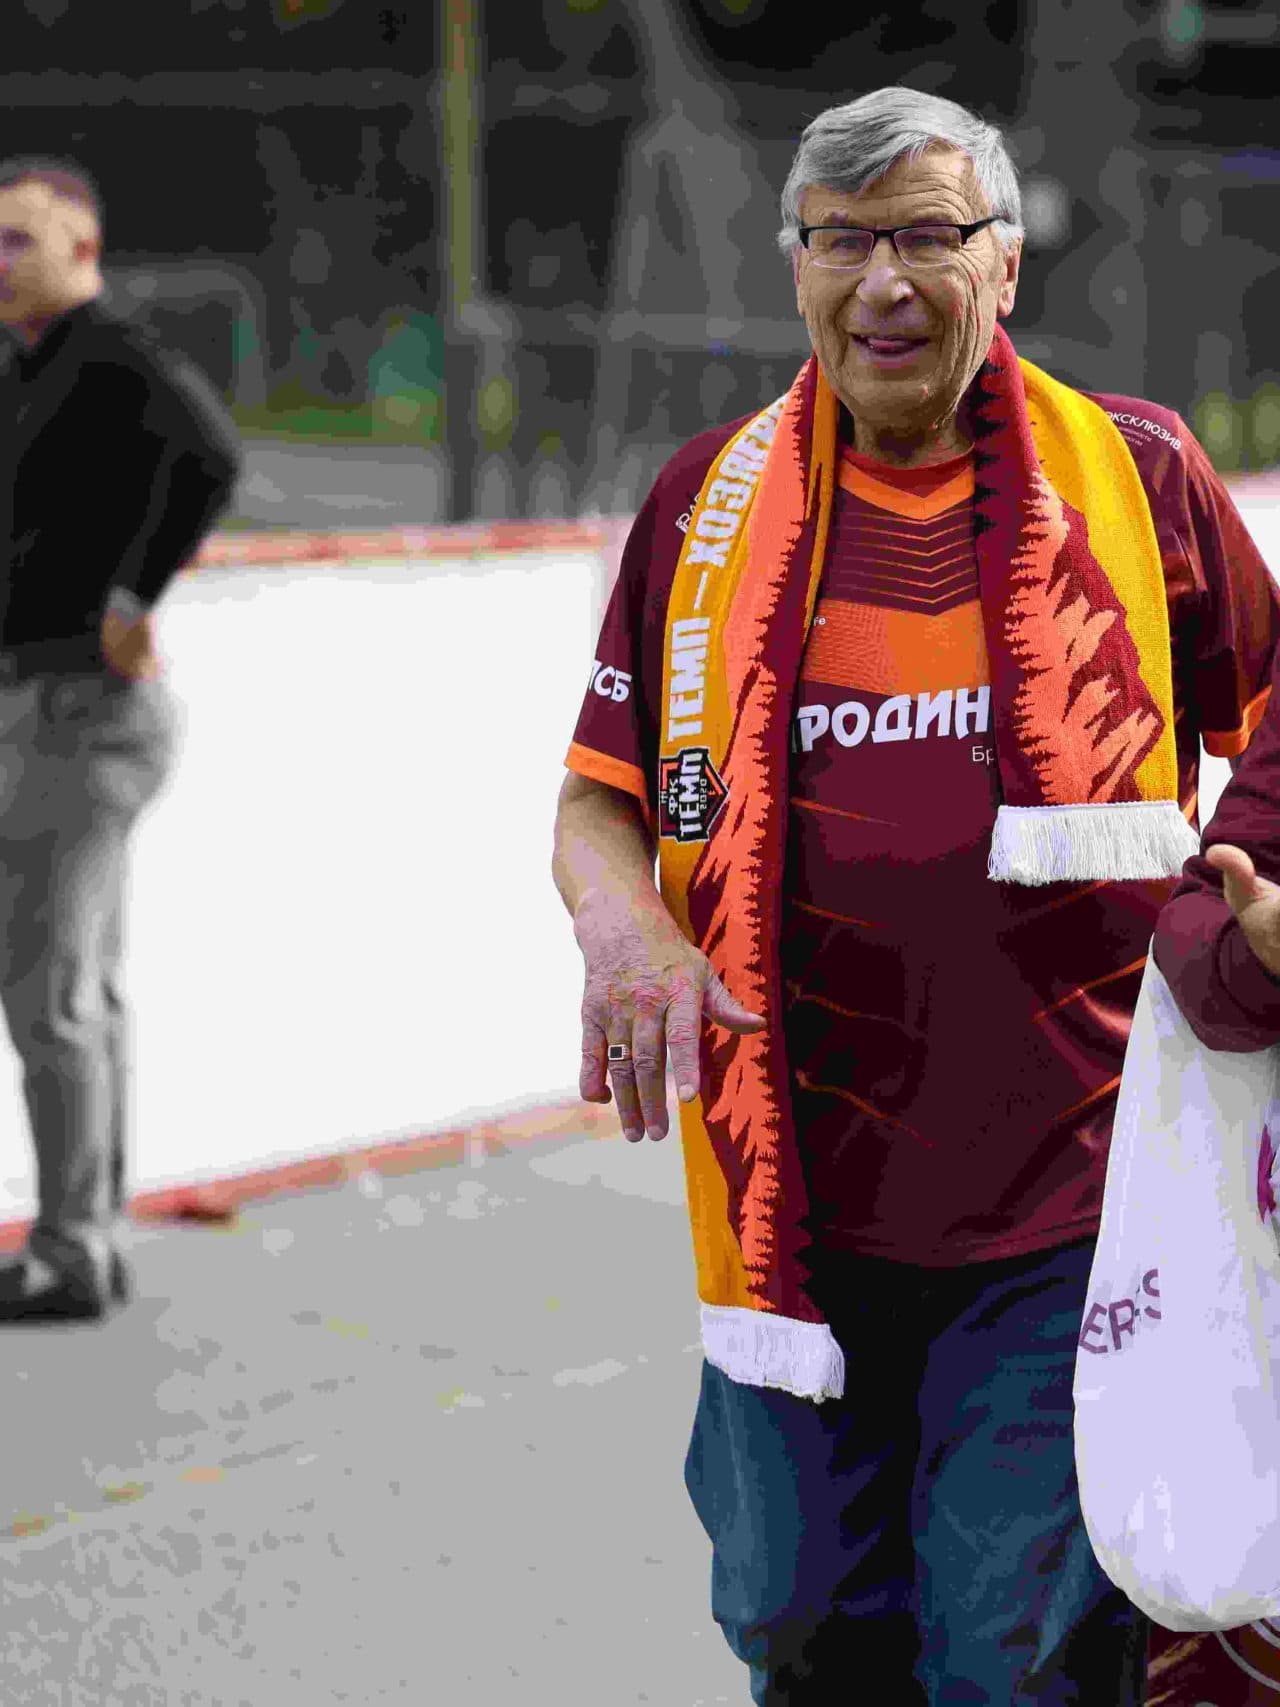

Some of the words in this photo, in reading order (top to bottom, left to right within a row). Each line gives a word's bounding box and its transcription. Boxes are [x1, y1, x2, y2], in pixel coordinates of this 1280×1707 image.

[667, 616, 711, 744] ТЕМП
[796, 685, 991, 753] РОДИН
[668, 778, 679, 816] ФК
[678, 752, 703, 837] ТЕМП
[699, 778, 708, 810] 2020
